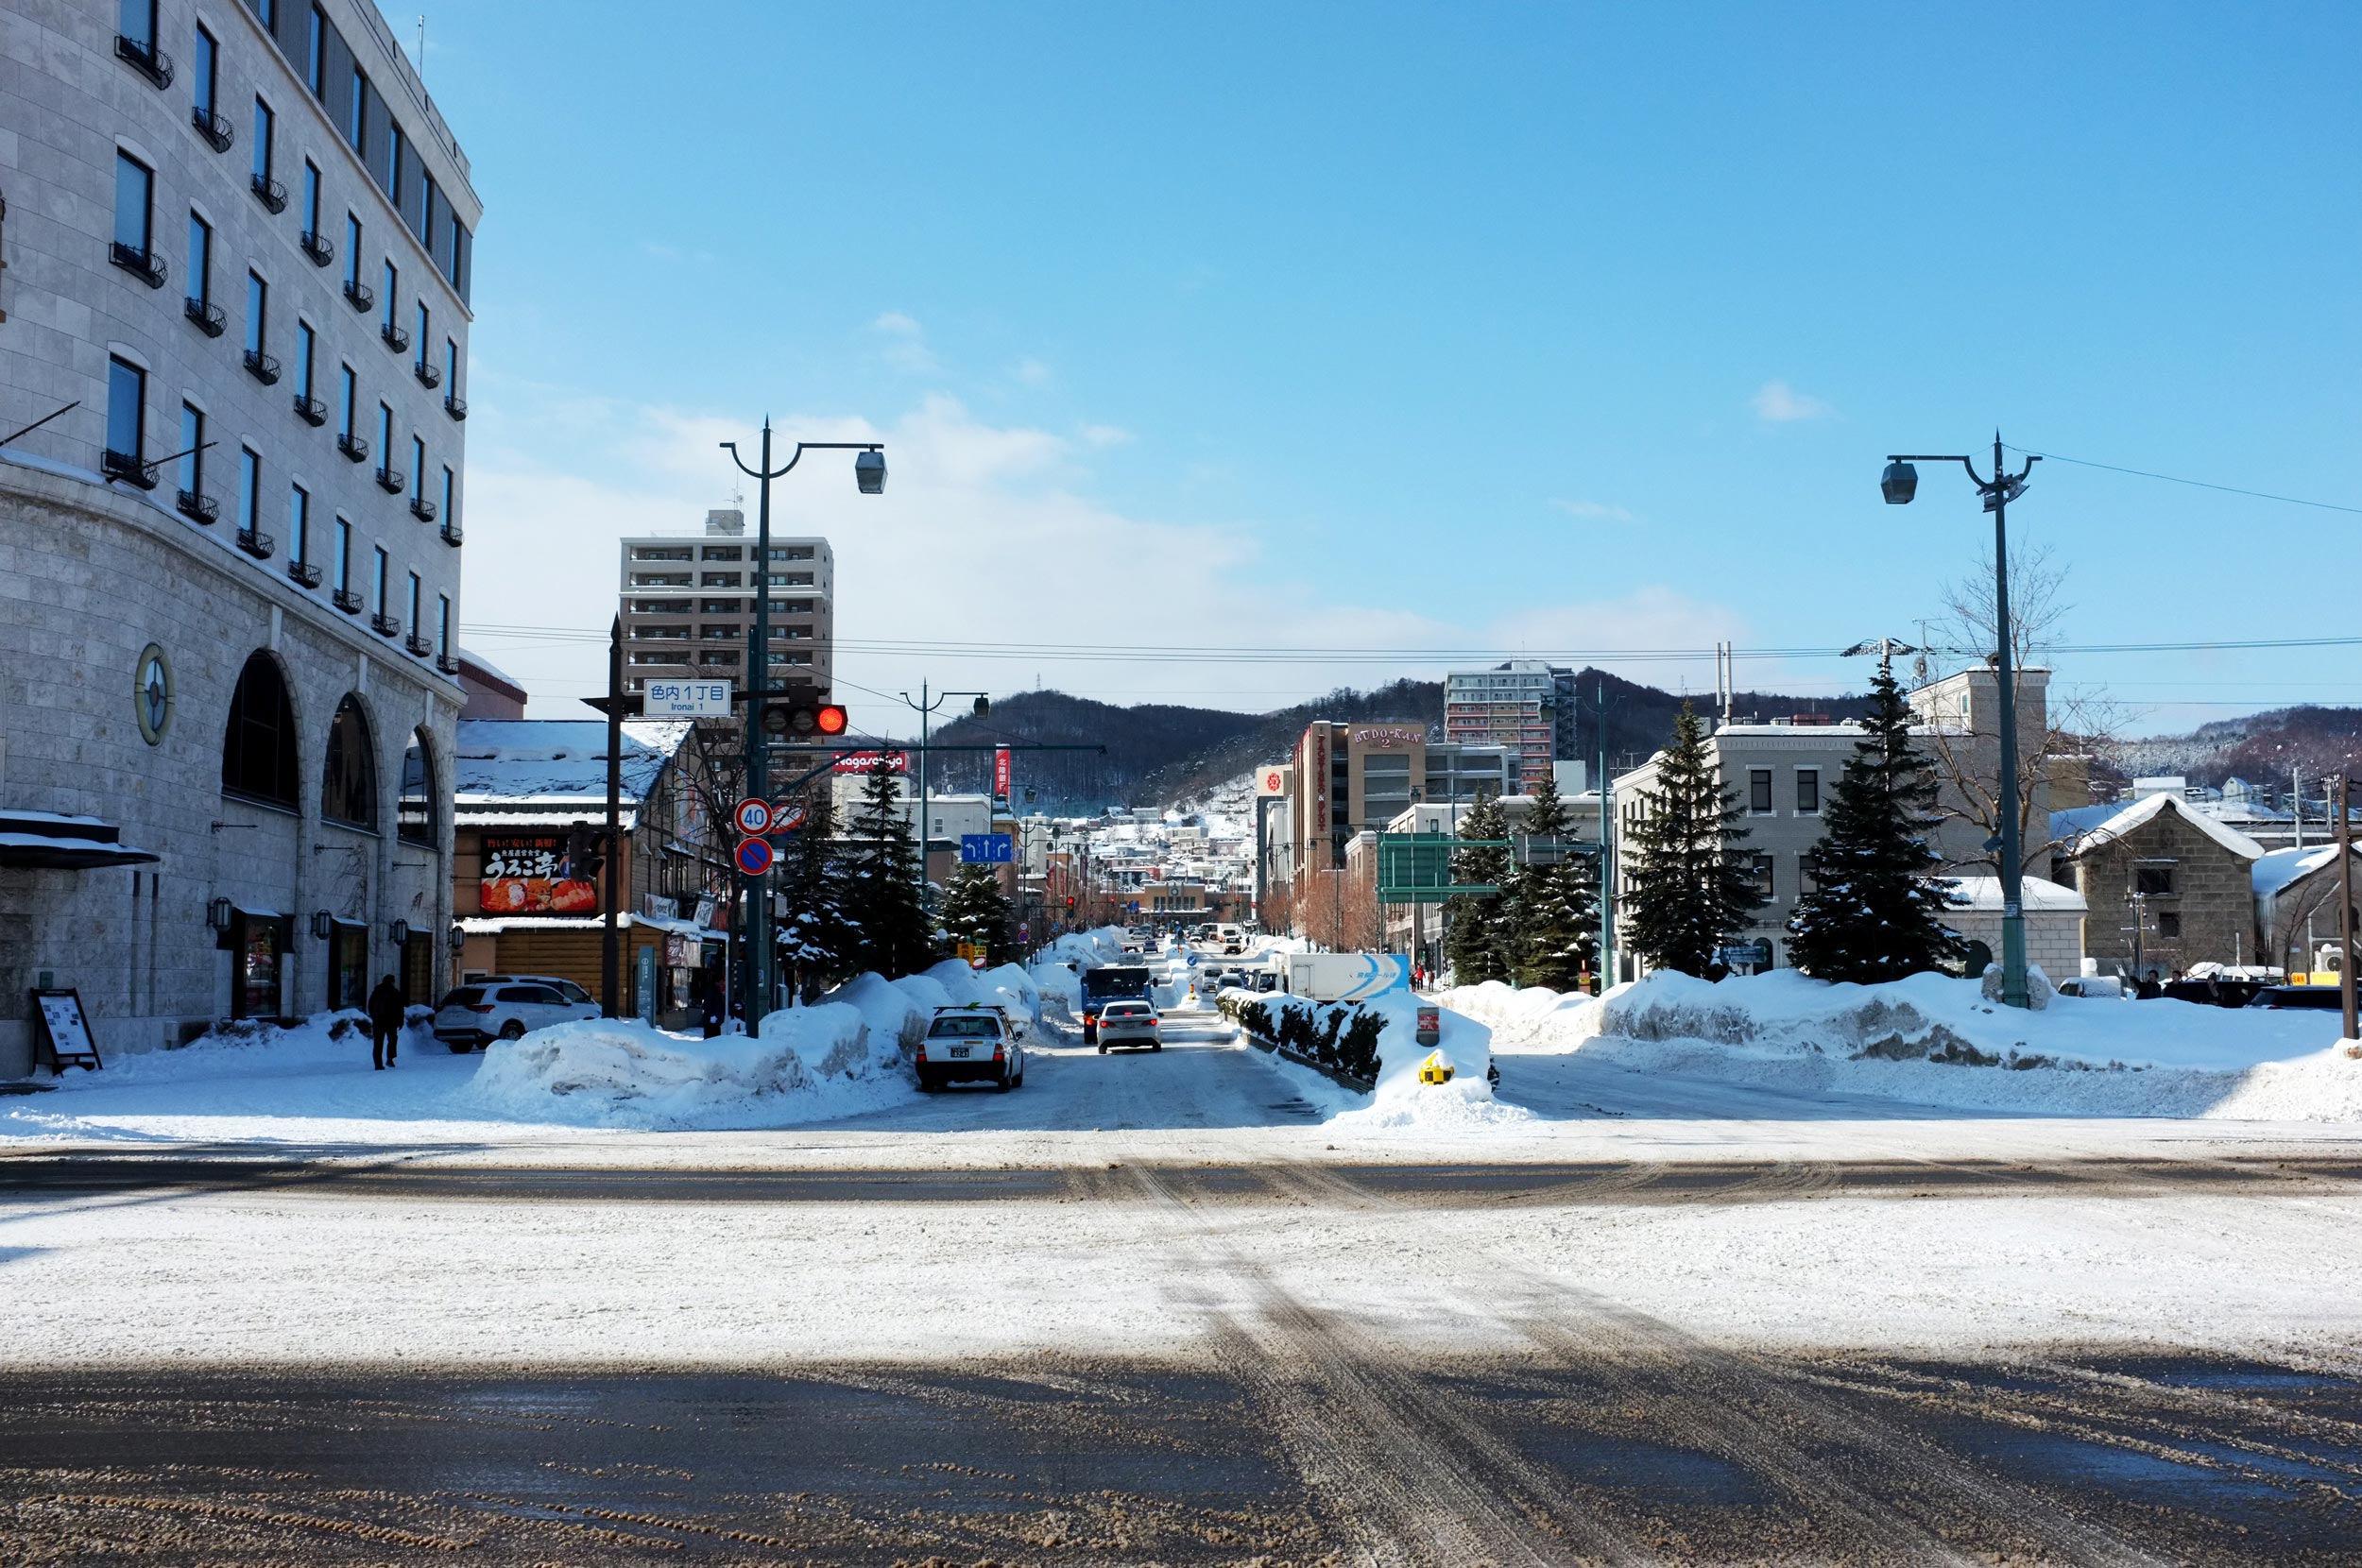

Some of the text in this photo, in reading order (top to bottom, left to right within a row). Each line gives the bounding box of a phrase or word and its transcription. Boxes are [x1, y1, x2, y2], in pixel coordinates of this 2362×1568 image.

[651, 685, 724, 701] 色内1丁目
[671, 703, 704, 711] Ironai 1
[1354, 728, 1421, 743] BUDO-KAN
[1381, 739, 1391, 748] 2
[744, 809, 764, 826] 40
[485, 852, 558, 882] うろこ亭
